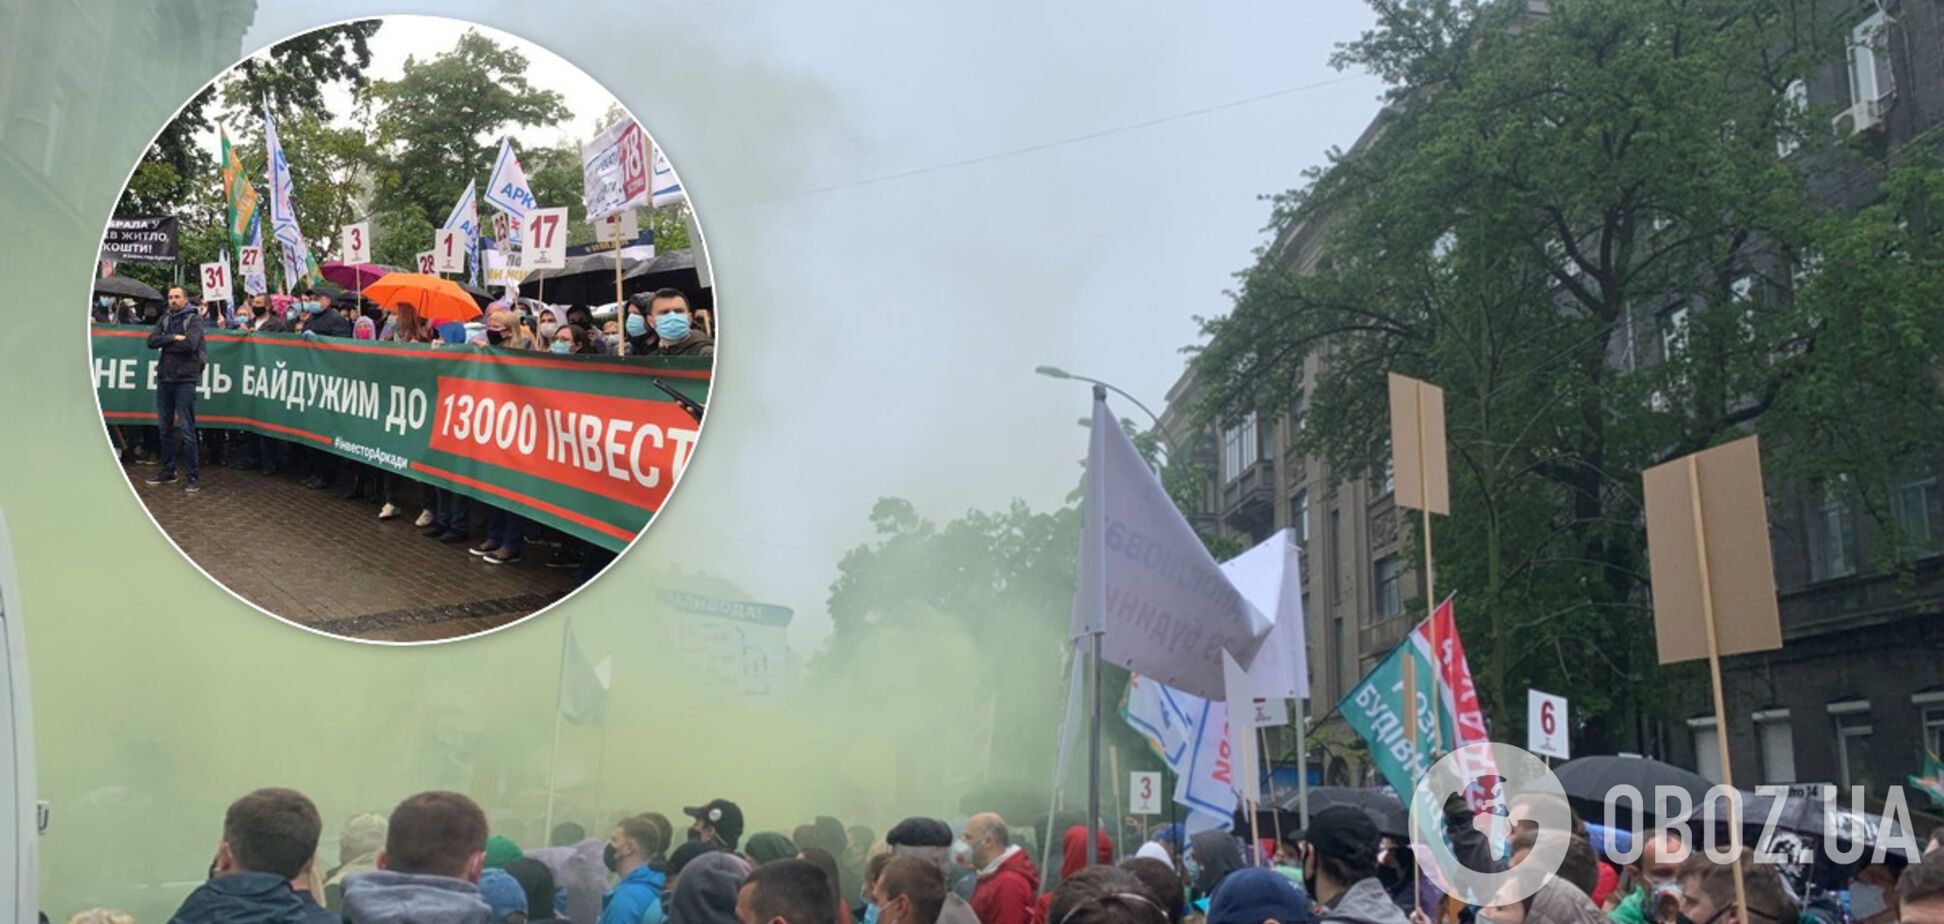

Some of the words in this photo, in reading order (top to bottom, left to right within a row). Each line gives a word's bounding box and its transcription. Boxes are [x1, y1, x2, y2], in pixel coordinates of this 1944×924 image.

[350, 227, 362, 251] 3
[529, 214, 560, 249] 17
[242, 248, 258, 266] 27
[443, 233, 453, 257] 1
[205, 266, 225, 288] 31
[419, 256, 435, 274] 28
[96, 358, 136, 390] НЕ
[242, 361, 379, 421] БАЙДУЖИМ
[384, 385, 427, 435] ДО
[442, 392, 537, 455] 13000
[1539, 700, 1557, 736] 6
[1140, 776, 1152, 800] 3
